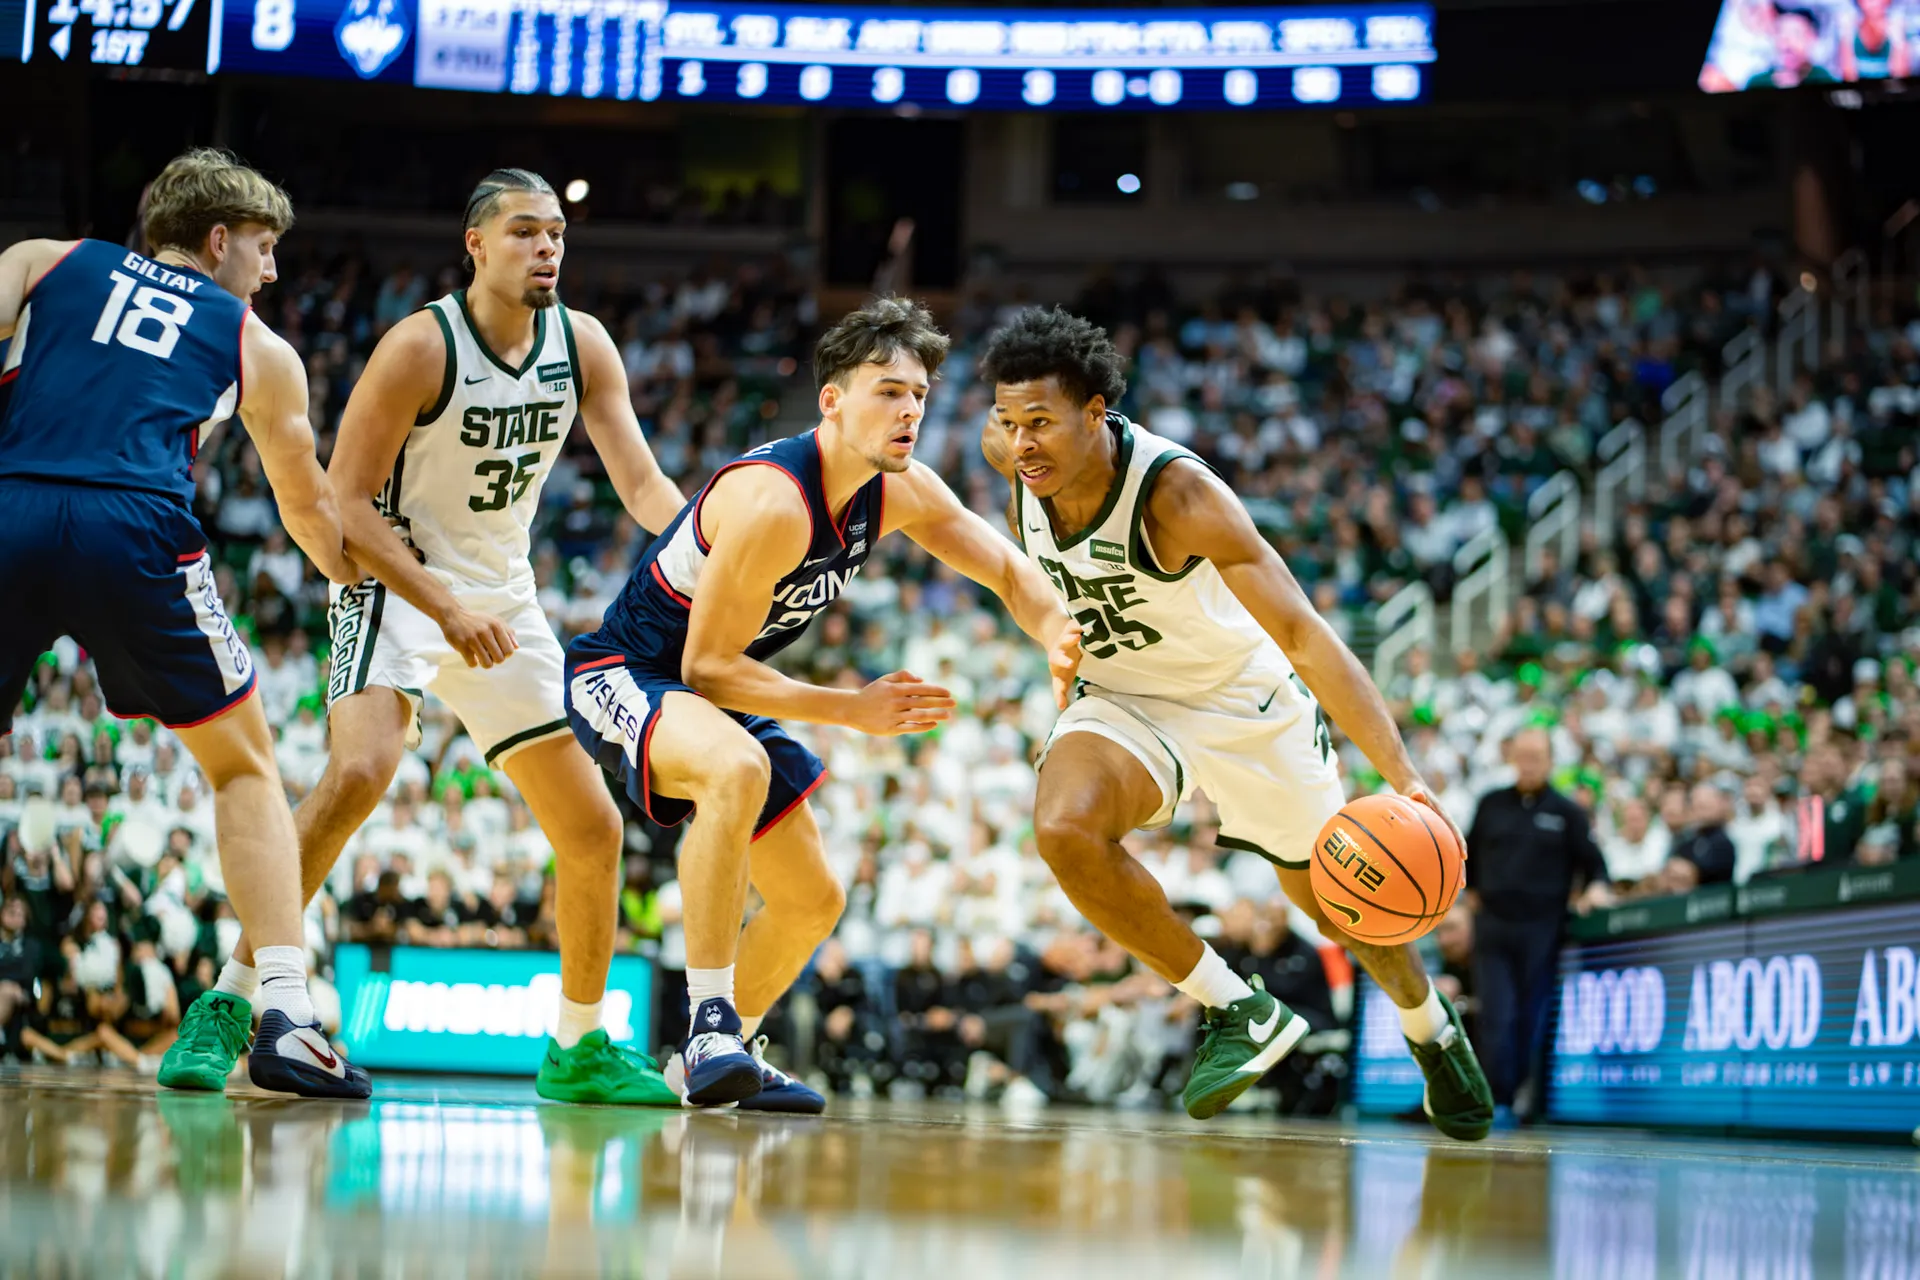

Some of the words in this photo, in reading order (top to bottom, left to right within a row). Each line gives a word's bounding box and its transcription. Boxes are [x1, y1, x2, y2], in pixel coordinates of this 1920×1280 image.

[122, 251, 203, 293] GILTAY
[91, 269, 194, 359] 18
[460, 400, 565, 449] STATE
[468, 451, 541, 512] 35
[1095, 545, 1125, 557] msufcu
[1323, 831, 1386, 893] ELITE
[1683, 954, 1822, 1052] ABOOD
[1850, 946, 1920, 1047] AB
[1849, 1062, 1891, 1086] LAW
